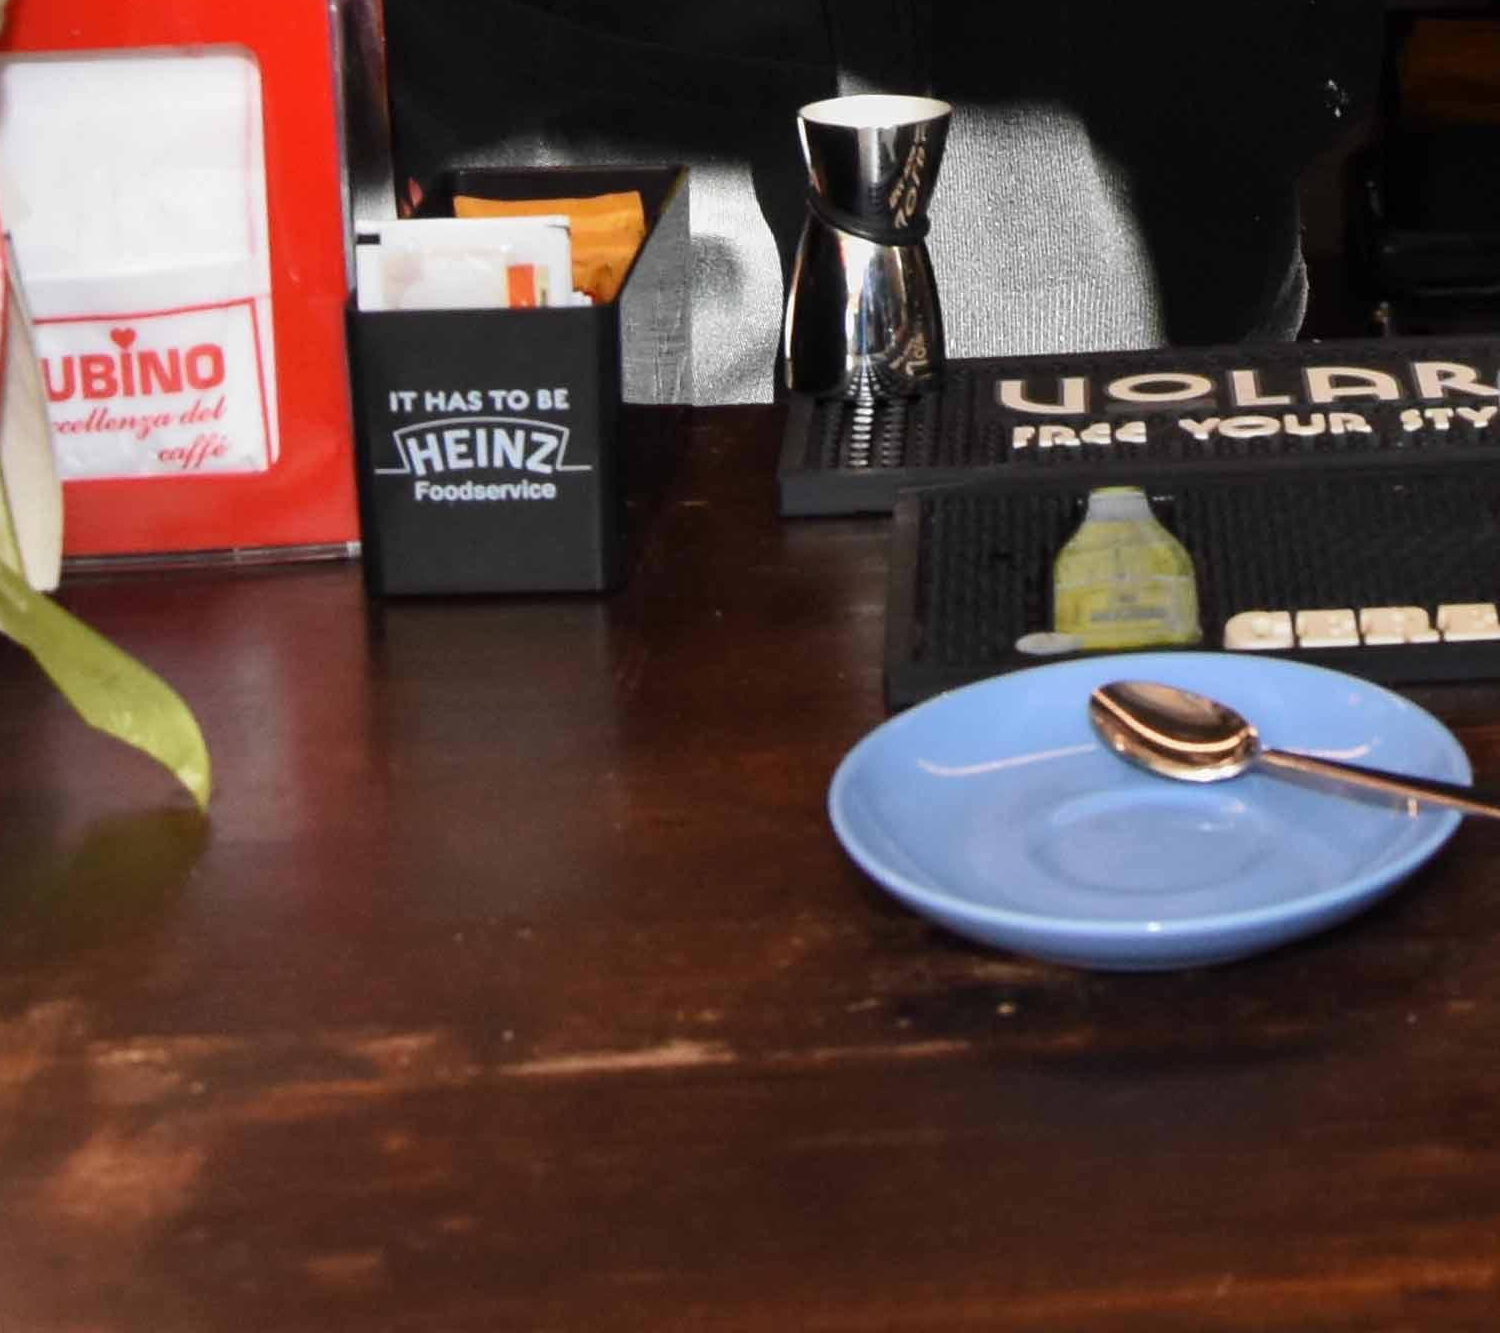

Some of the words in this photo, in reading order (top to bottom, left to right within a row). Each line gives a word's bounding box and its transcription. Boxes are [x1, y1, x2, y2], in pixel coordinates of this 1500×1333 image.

[40, 338, 226, 403] UBINO
[52, 405, 173, 441] ccellenza
[179, 393, 226, 424] del
[388, 390, 419, 413] IT
[423, 390, 484, 413] HAS
[487, 389, 531, 411] TO
[535, 387, 571, 411] BE
[1011, 420, 1148, 450] FREE
[1177, 412, 1374, 442] YOUR
[1400, 405, 1499, 433] STY
[405, 428, 560, 478] HEINZ
[413, 478, 558, 502] Foodservice
